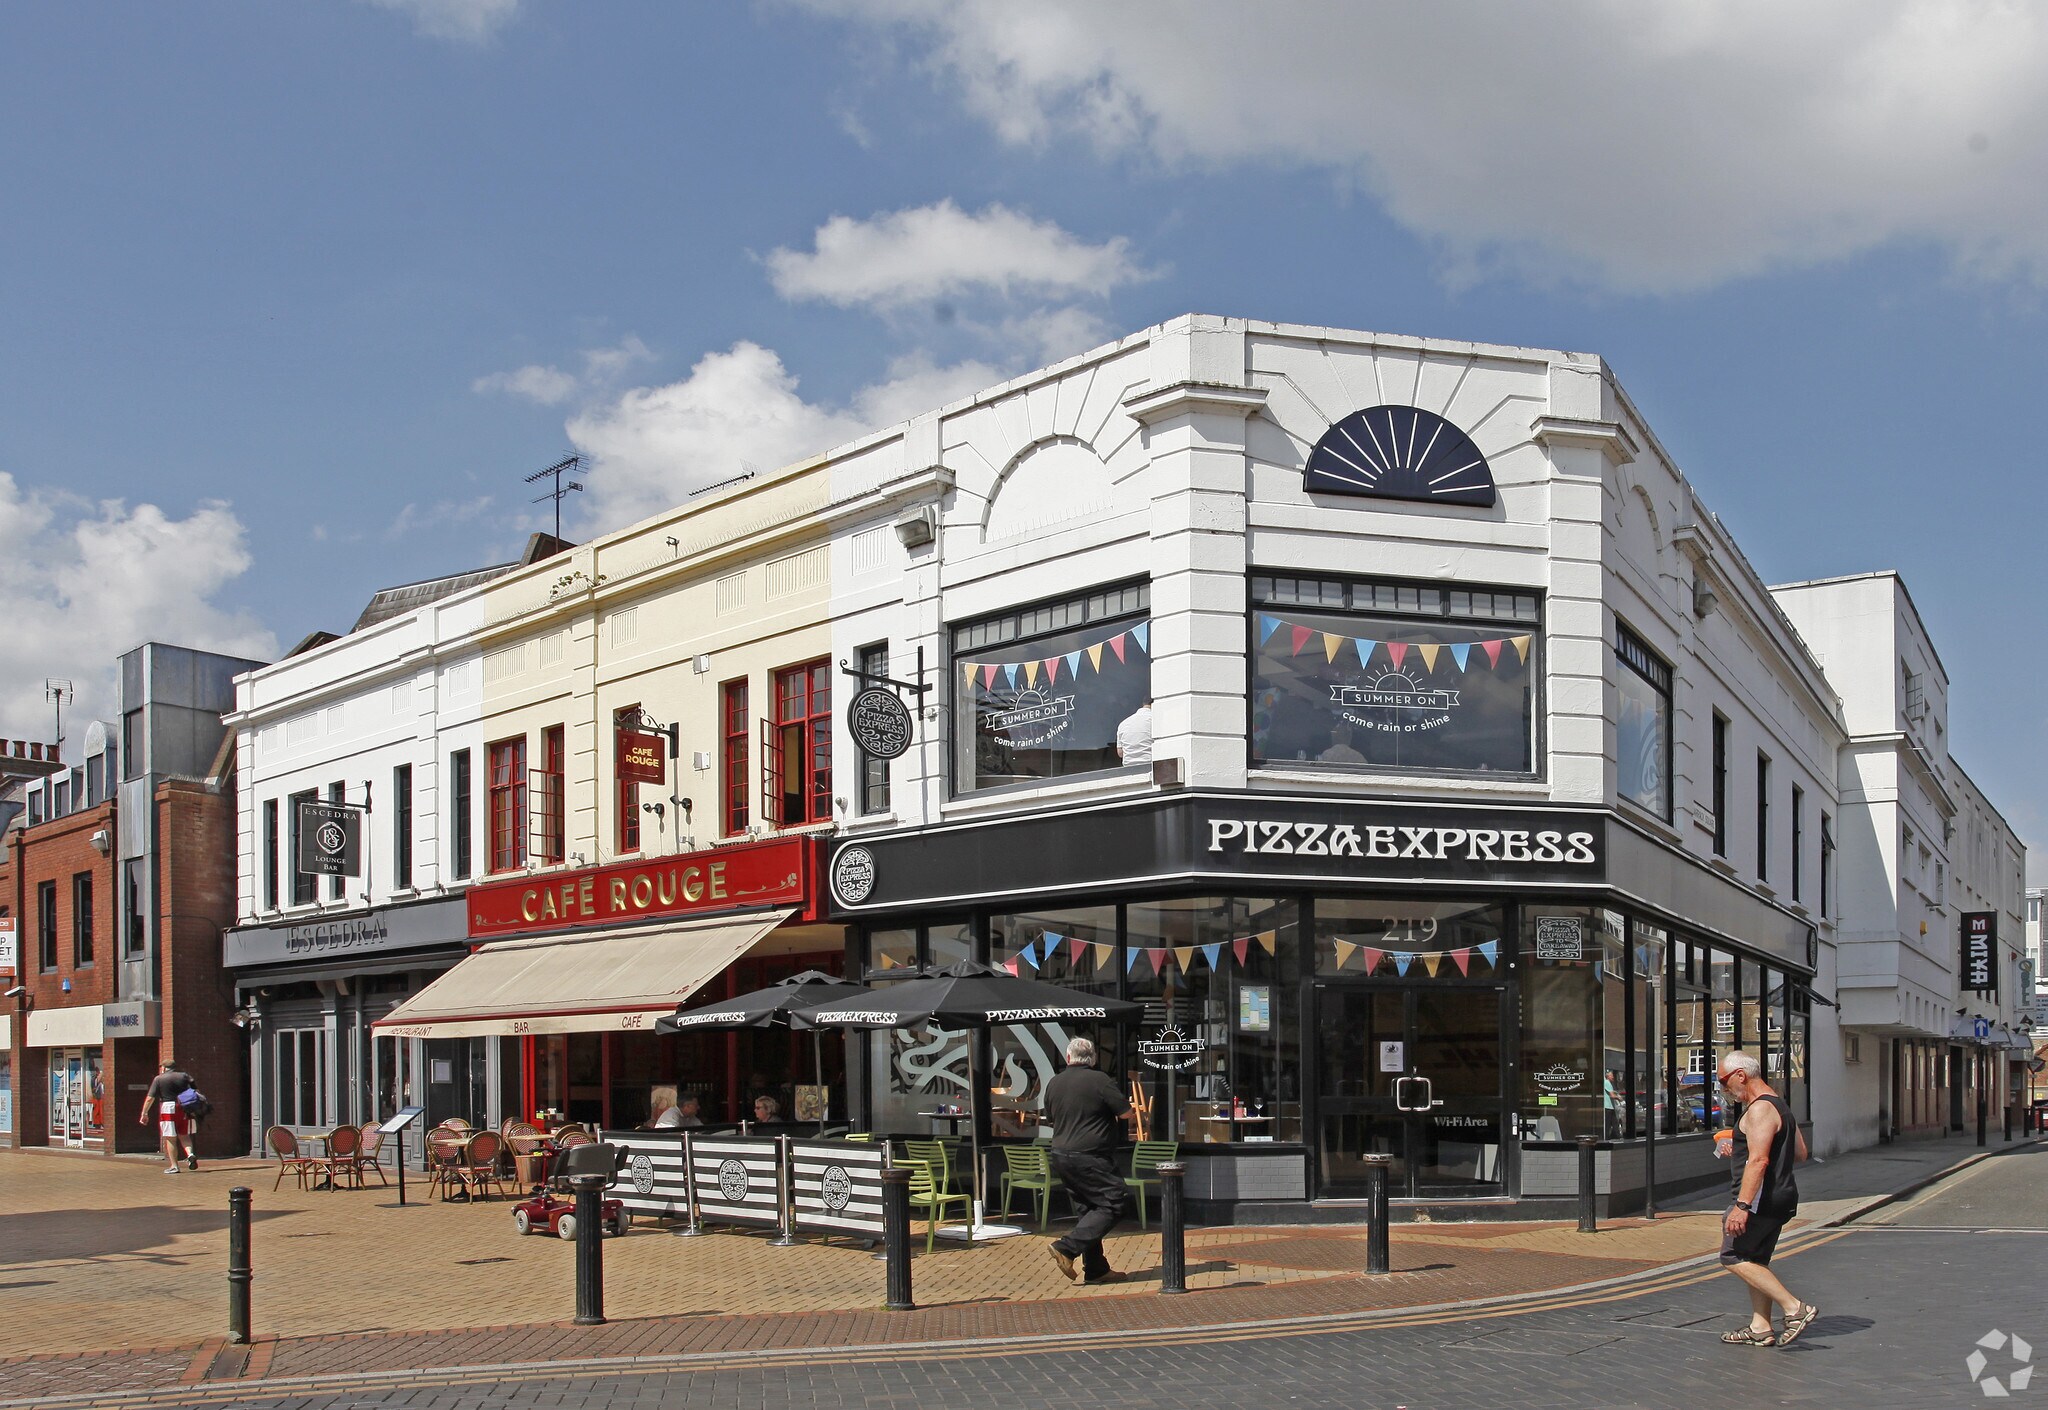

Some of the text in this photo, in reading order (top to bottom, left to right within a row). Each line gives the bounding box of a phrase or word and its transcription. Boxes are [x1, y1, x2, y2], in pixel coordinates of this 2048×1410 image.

[1355, 693, 1436, 706] SUMMER ON
[867, 711, 896, 725] PIZZA
[1002, 705, 1058, 725] SUMMER ON
[1342, 712, 1450, 732] come rain or shine
[858, 717, 904, 735] EXPRESS
[994, 720, 1069, 748] come rain or shine
[625, 754, 660, 768] ROUGE
[305, 807, 357, 820] ESCEDRA
[1207, 818, 1596, 864] PIZZAEXPRESS
[315, 855, 347, 864] LOUNGE
[323, 863, 338, 871] BAR
[846, 865, 866, 875] PIZZA
[840, 871, 871, 882] EXPRESS
[520, 861, 728, 922] CAFÉ ROUGE
[1381, 915, 1438, 942] 219
[1972, 919, 1986, 931] M
[288, 918, 385, 954] ESCEDRA
[621, 1013, 643, 1028] CAFÉ
[677, 1011, 746, 1027] PIZZAEXPRESS
[815, 1011, 898, 1025] PIZZAEXPRESS
[985, 1007, 1107, 1022] PIZZAEXPRESS
[514, 1021, 530, 1034] BAR
[1150, 1044, 1180, 1052] SUMMER
[1143, 1058, 1160, 1069] come
[1161, 1062, 1174, 1070] rain
[1183, 1056, 1200, 1068] shine
[1434, 1116, 1488, 1127] Wi-Fi Area
